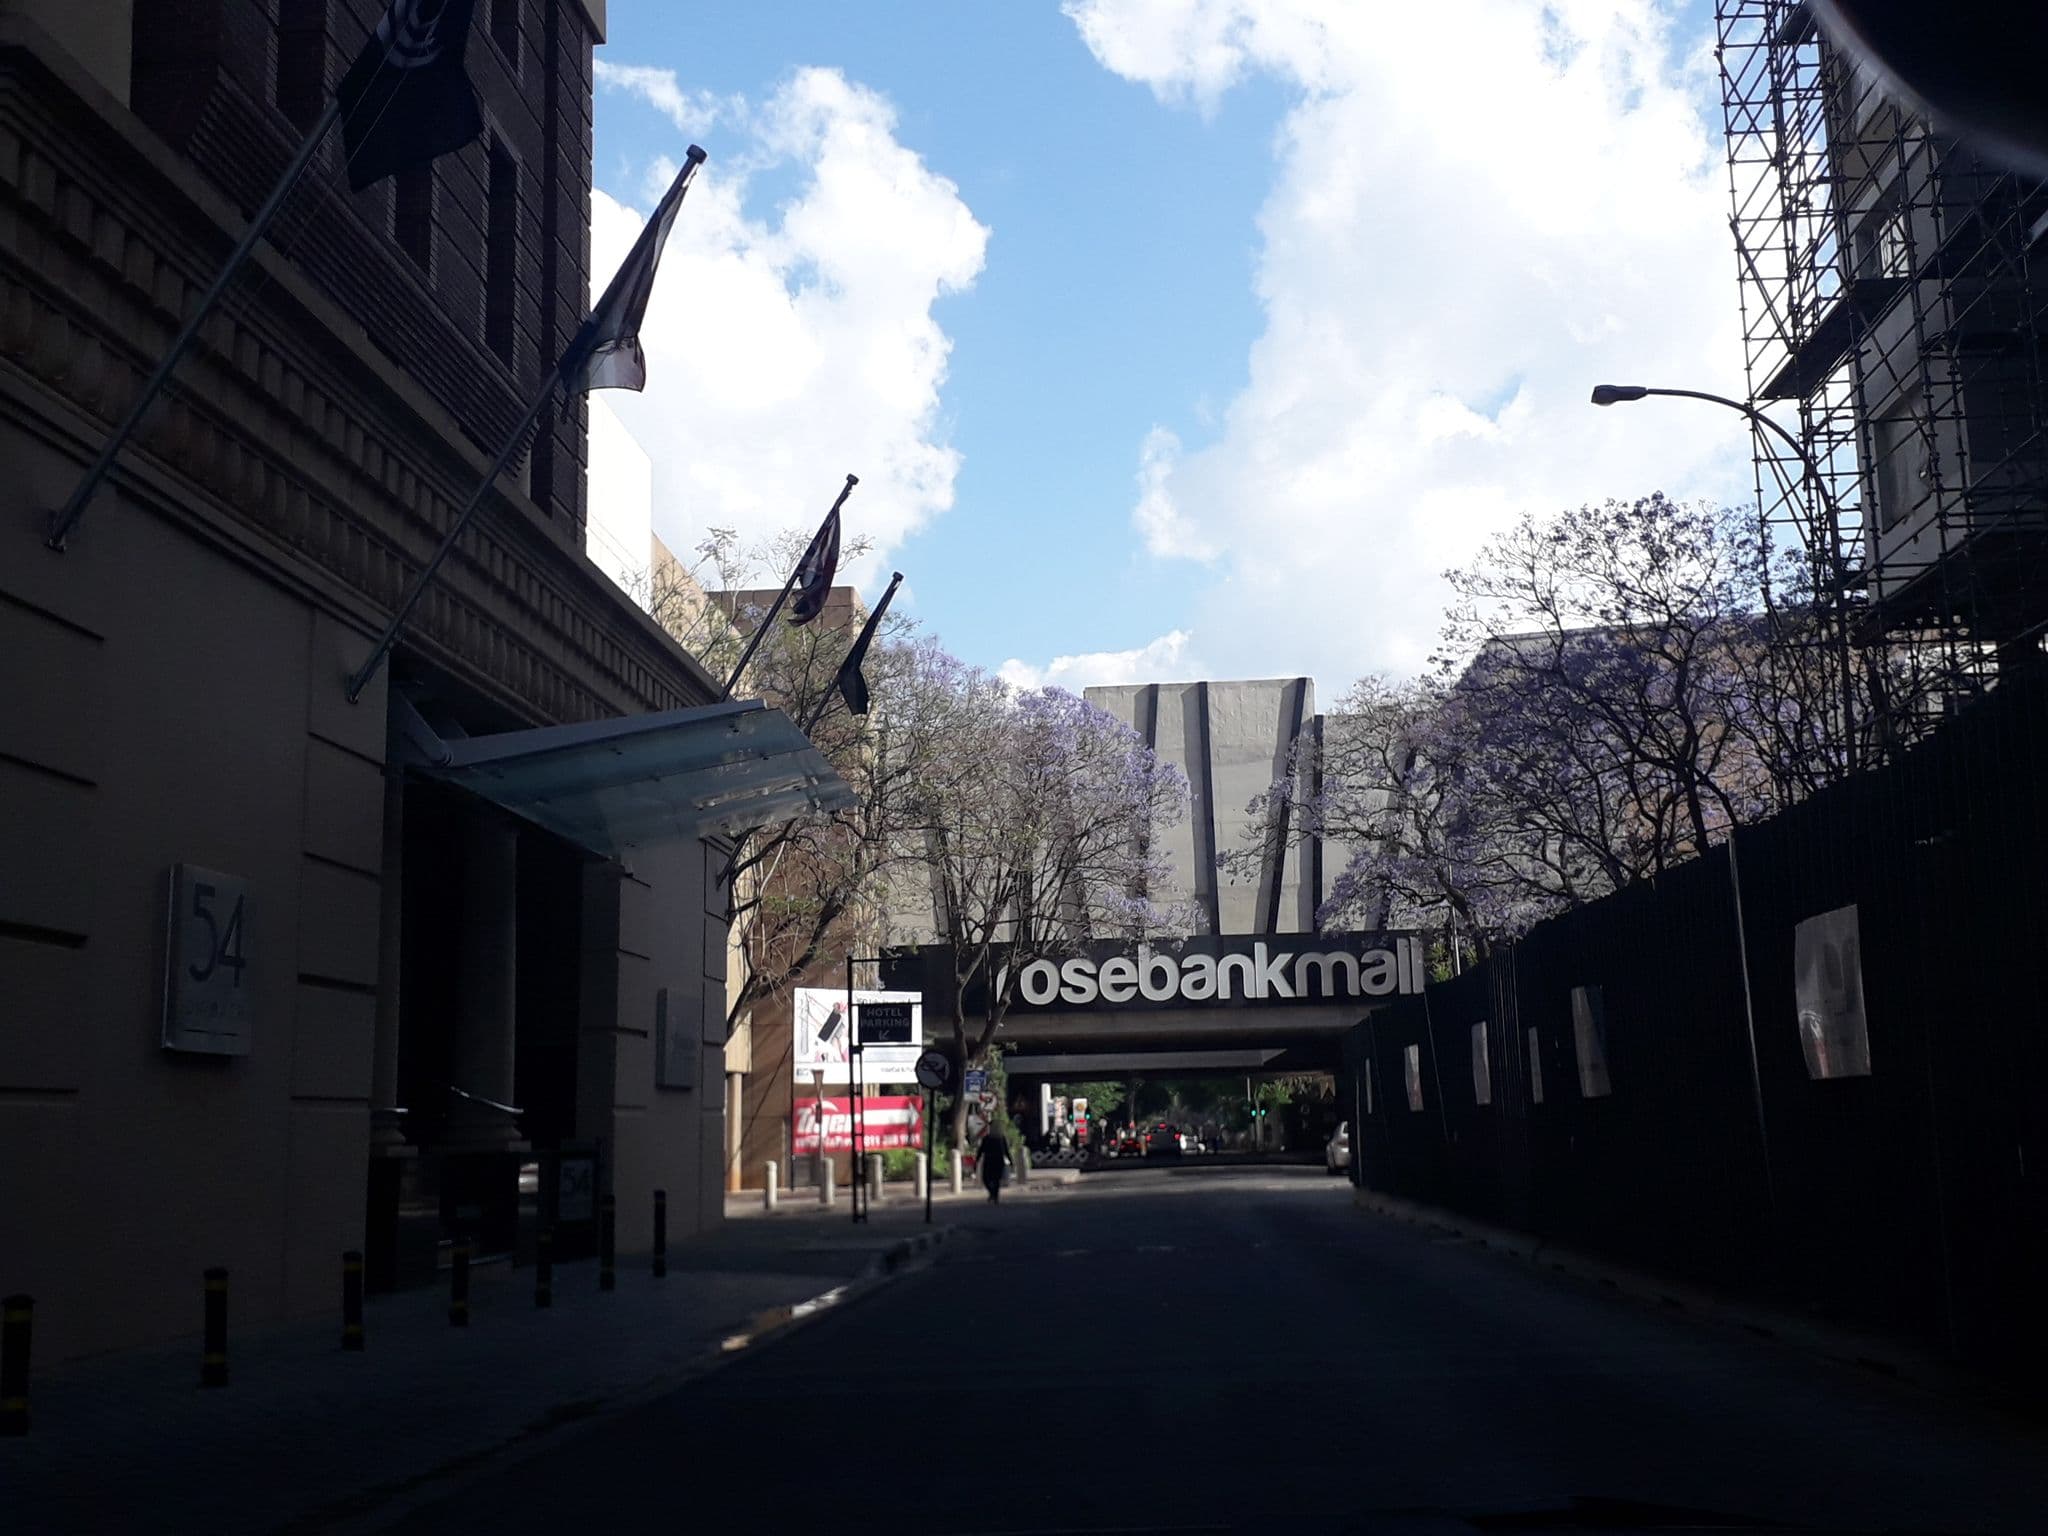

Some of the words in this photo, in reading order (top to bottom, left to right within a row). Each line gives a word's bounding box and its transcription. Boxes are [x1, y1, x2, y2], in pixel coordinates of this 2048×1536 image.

[188, 882, 247, 988] 54
[866, 1007, 903, 1017] HOTEL
[860, 1017, 910, 1028] PARKING
